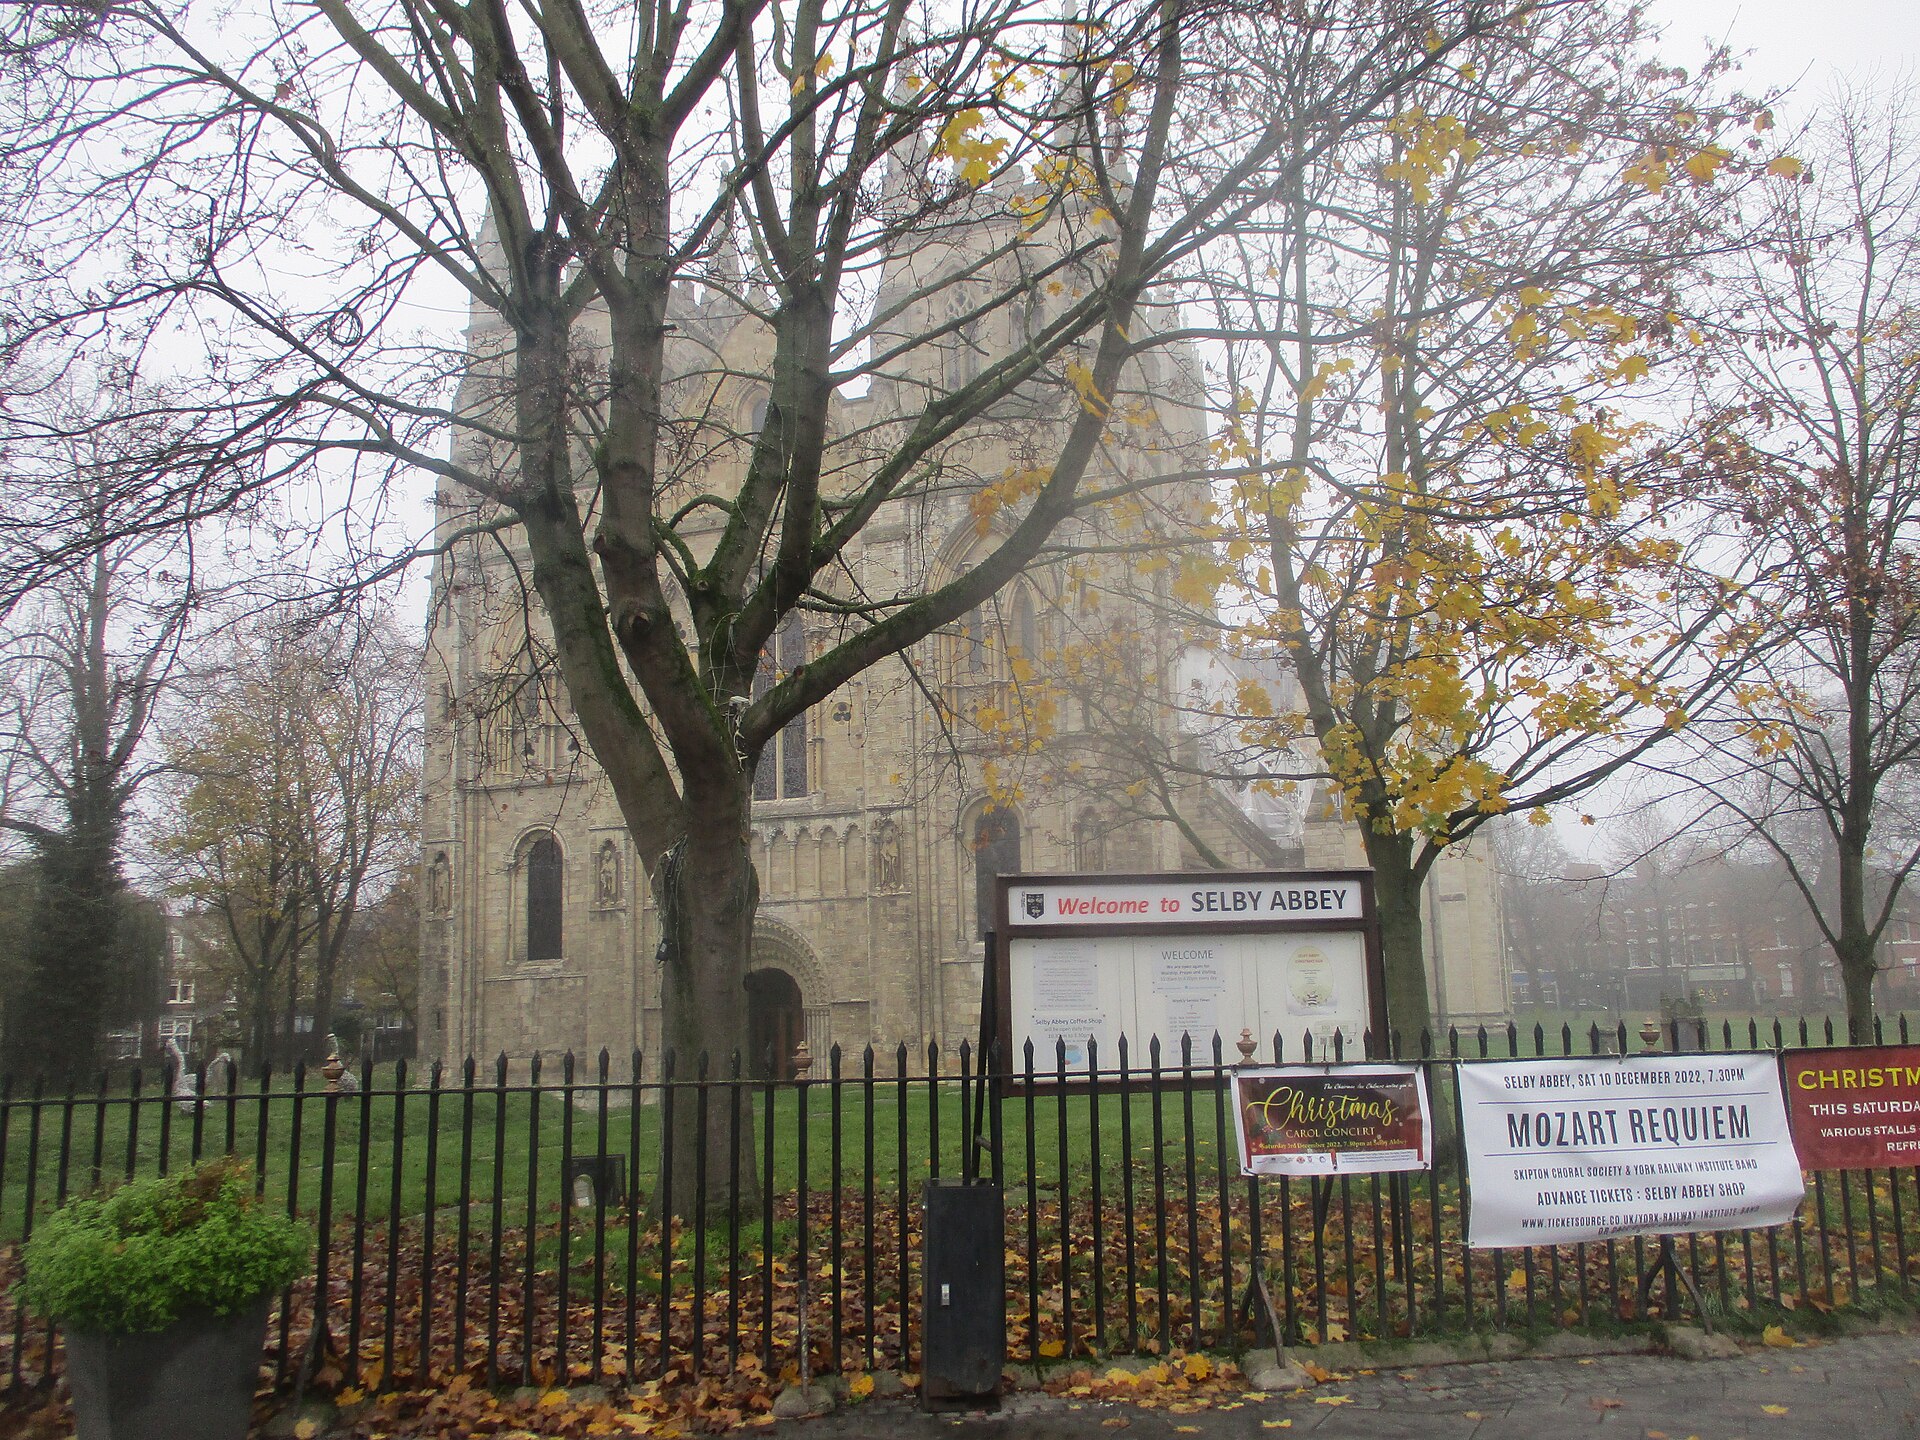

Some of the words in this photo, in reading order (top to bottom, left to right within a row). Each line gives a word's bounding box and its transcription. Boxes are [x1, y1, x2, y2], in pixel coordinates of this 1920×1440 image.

[1057, 896, 1149, 915] Welcome
[1160, 896, 1180, 913] to
[1191, 890, 1262, 913] SELBY
[1270, 888, 1347, 912] ABBEY
[1161, 950, 1213, 960] WELCOME
[1504, 1074, 1536, 1090] SELBY
[1539, 1073, 1575, 1090] ABBEY,
[1578, 1073, 1597, 1087] SAT
[1599, 1072, 1612, 1086] 10
[1614, 1071, 1671, 1086] DECEMBER
[1675, 1070, 1705, 1085] 2022,
[1708, 1068, 1745, 1083] 7.30PM
[1245, 1086, 1400, 1130] Christmas
[1809, 1104, 1847, 1116] THIS
[1285, 1128, 1320, 1139] CAROL
[1323, 1126, 1375, 1138] CONCERT
[1507, 1109, 1619, 1148] MOZART
[1629, 1104, 1751, 1146] REQUIEM
[1821, 1127, 1871, 1137] VARIOUS
[1874, 1124, 1916, 1135] STALLS
[1261, 1142, 1287, 1151] Saturday
[1296, 1141, 1325, 1150] December
[1513, 1168, 1550, 1181] SKIPTON
[1551, 1167, 1585, 1179] CHORAL
[1587, 1165, 1623, 1177] SOCIETY
[1625, 1165, 1632, 1176] &
[1633, 1164, 1656, 1175] YORK
[1658, 1162, 1694, 1175] RAILWAY
[1694, 1160, 1734, 1172] INSTITUTE
[1735, 1158, 1758, 1170] BAND
[1537, 1189, 1587, 1206] ADVANCE
[1590, 1188, 1634, 1204] TICKETS
[1644, 1185, 1677, 1201] SELBY
[1681, 1183, 1715, 1199] ABBEY
[1719, 1182, 1746, 1197] SHOP
